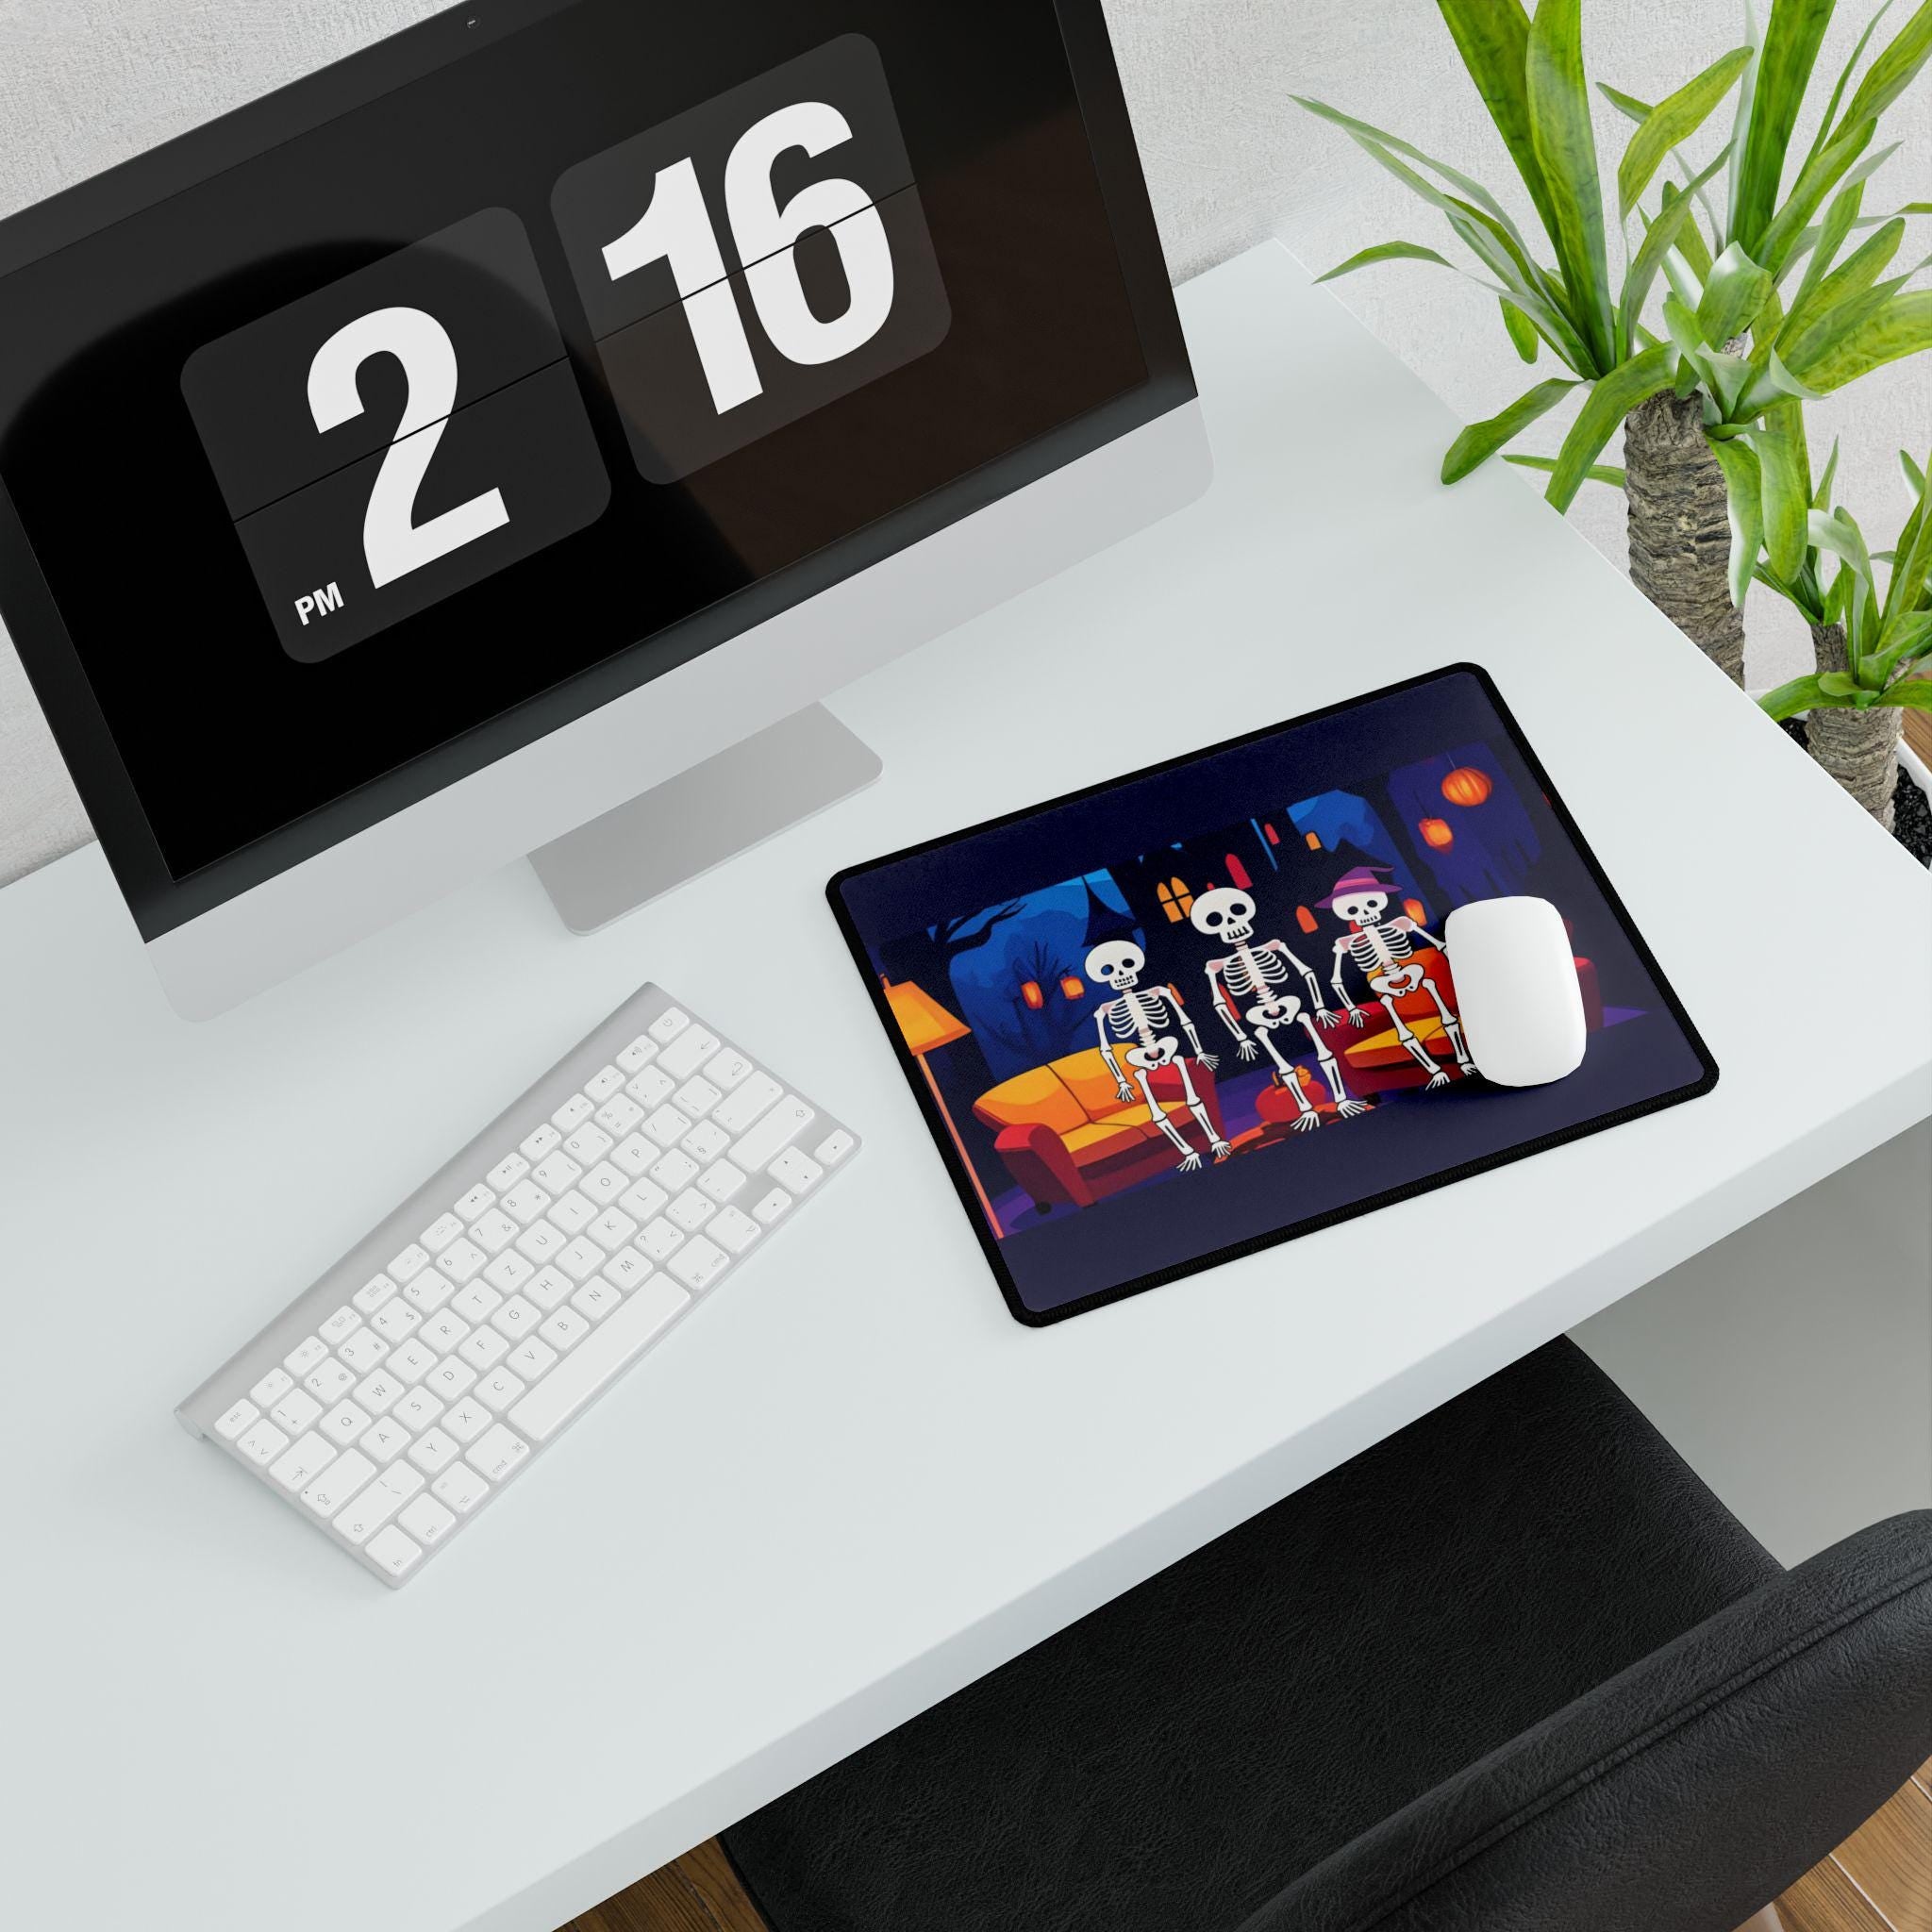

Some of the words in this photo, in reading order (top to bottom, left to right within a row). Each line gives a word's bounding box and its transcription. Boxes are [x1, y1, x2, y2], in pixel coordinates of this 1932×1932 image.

[308, 307, 509, 589] 2
[602, 102, 893, 414] 16
[295, 582, 343, 625] PM
[630, 1148, 641, 1158] P
[539, 1170, 547, 1178] 9
[507, 1199, 517, 1208] 8
[604, 1221, 616, 1231] K
[475, 1227, 483, 1237] 7
[535, 1235, 550, 1246] U
[575, 1251, 584, 1260] J
[443, 1257, 453, 1266] 6
[620, 1259, 635, 1273] M
[504, 1264, 516, 1276] Z
[540, 1279, 554, 1291] H
[410, 1287, 420, 1297] 5
[589, 1290, 602, 1302] N
[472, 1294, 483, 1304] T
[508, 1309, 520, 1320] G
[379, 1317, 388, 1325] 4
[557, 1321, 569, 1331] B
[439, 1325, 451, 1335] R
[475, 1340, 486, 1350] F
[344, 1347, 355, 1357] 3
[525, 1350, 535, 1359] V
[407, 1355, 419, 1366] E
[442, 1371, 455, 1381] D
[310, 1377, 323, 1388] 2
[492, 1381, 505, 1391] C
[372, 1384, 386, 1397] W
[410, 1401, 422, 1411] S
[341, 1417, 354, 1427] Q
[459, 1412, 473, 1424] X
[378, 1433, 391, 1443] A
[425, 1442, 437, 1453] Y
